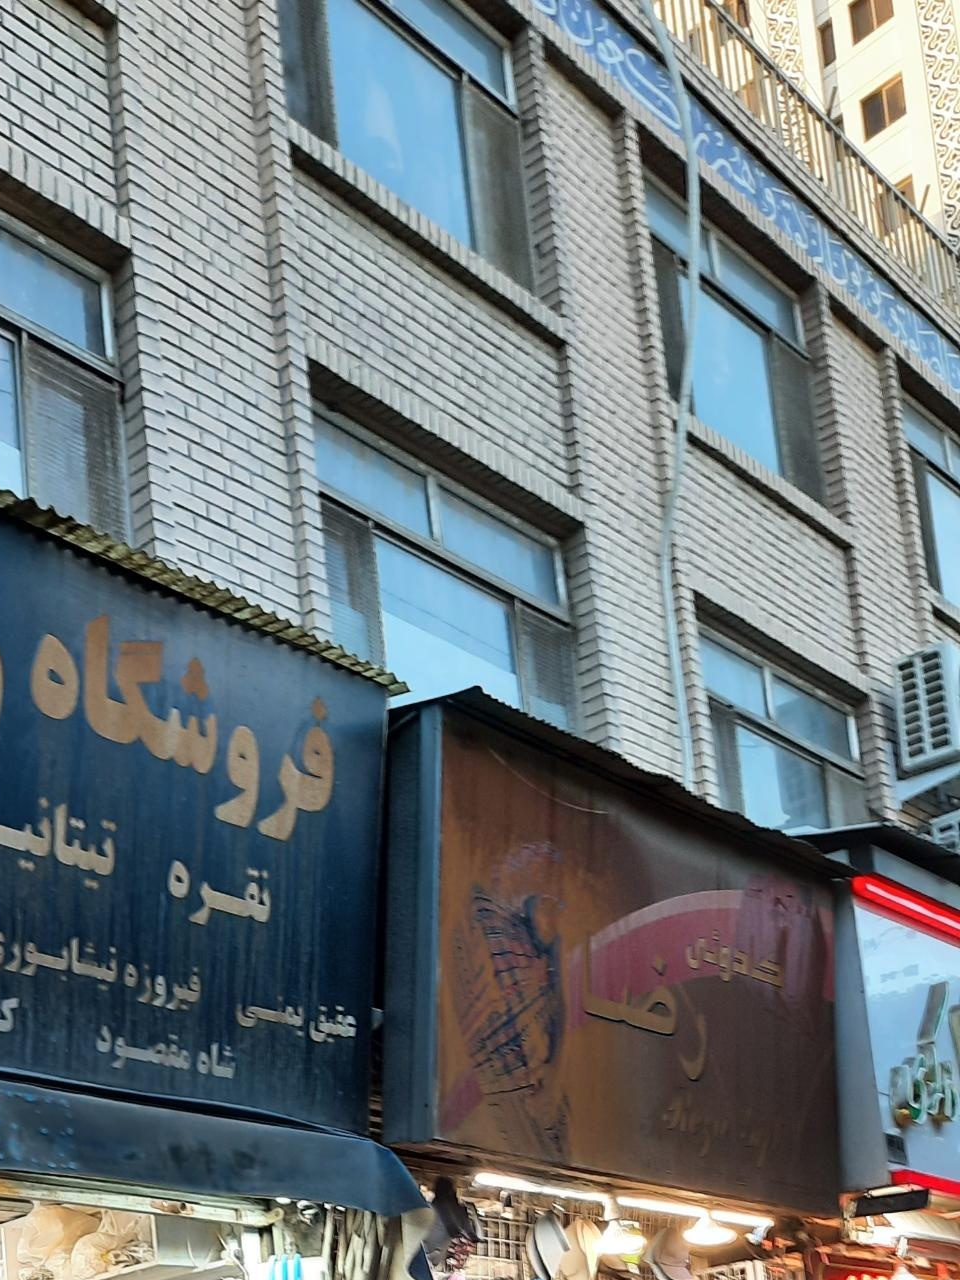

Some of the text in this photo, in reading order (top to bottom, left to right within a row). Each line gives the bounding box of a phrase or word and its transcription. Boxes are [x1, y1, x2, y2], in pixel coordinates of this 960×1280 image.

[30, 614, 334, 841] فروشگاه
[167, 860, 271, 925] نقره
[123, 963, 201, 1011] فیروزه
[235, 995, 304, 1038] یمنی
[308, 1005, 357, 1042] عقیق
[95, 1024, 190, 1070] مقصود
[196, 1042, 236, 1079] شاه
